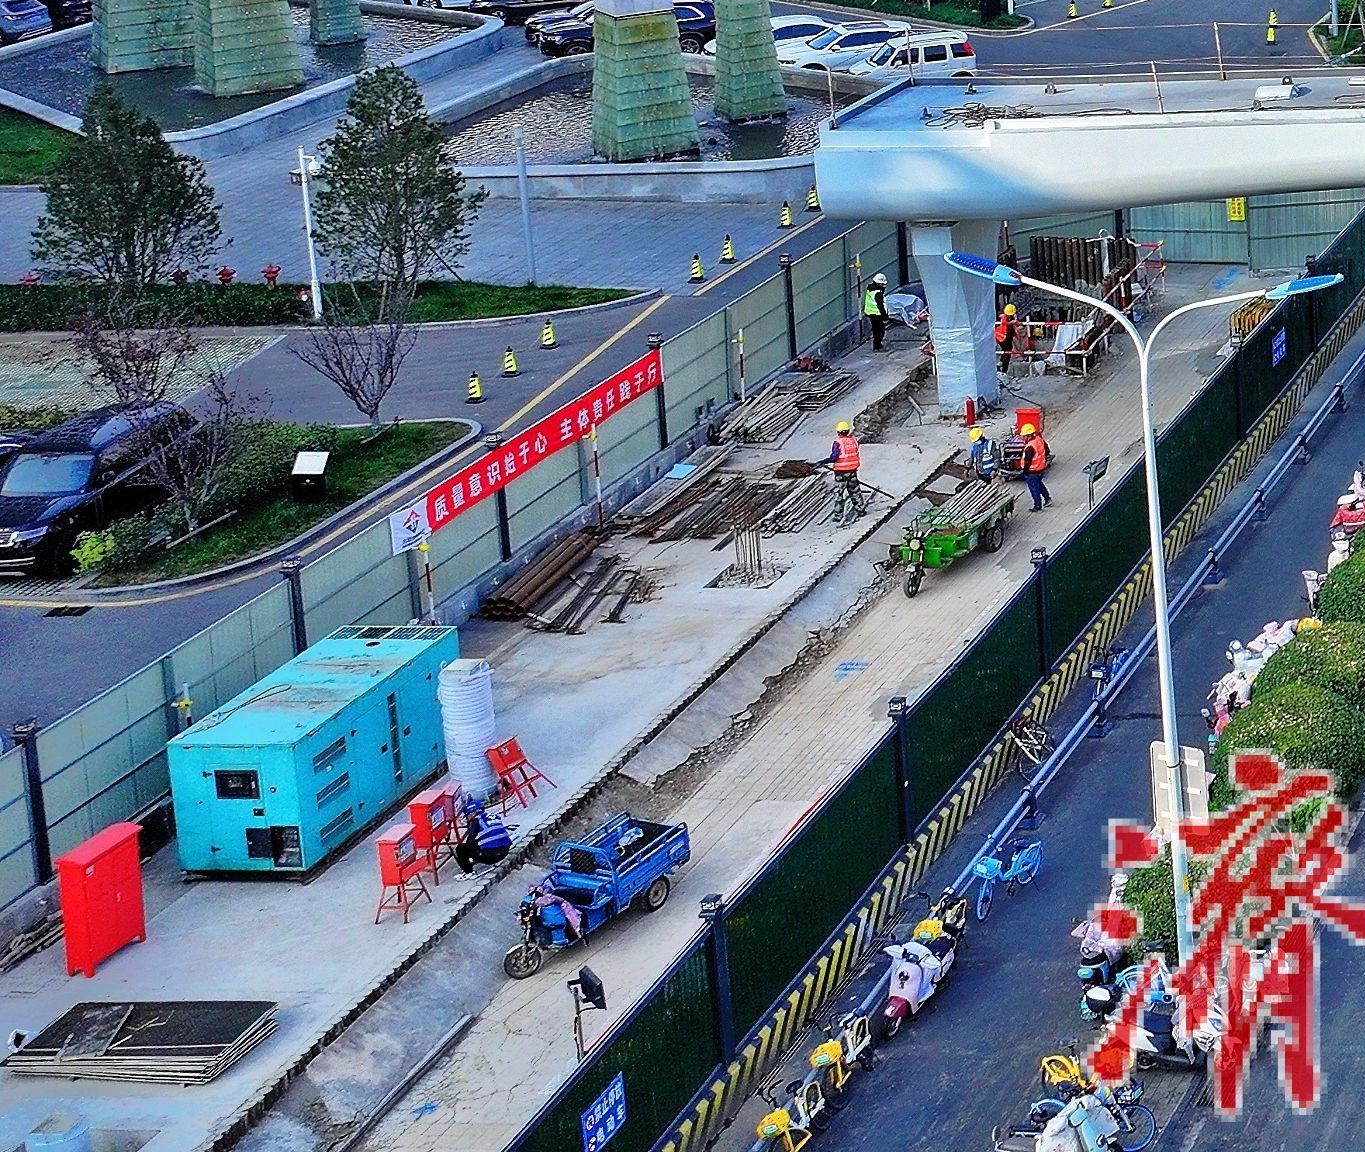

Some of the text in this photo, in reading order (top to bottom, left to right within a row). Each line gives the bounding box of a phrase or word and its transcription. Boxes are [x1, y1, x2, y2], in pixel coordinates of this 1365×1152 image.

[434, 361, 658, 523] 质量意识始于心 主体责任践于行
